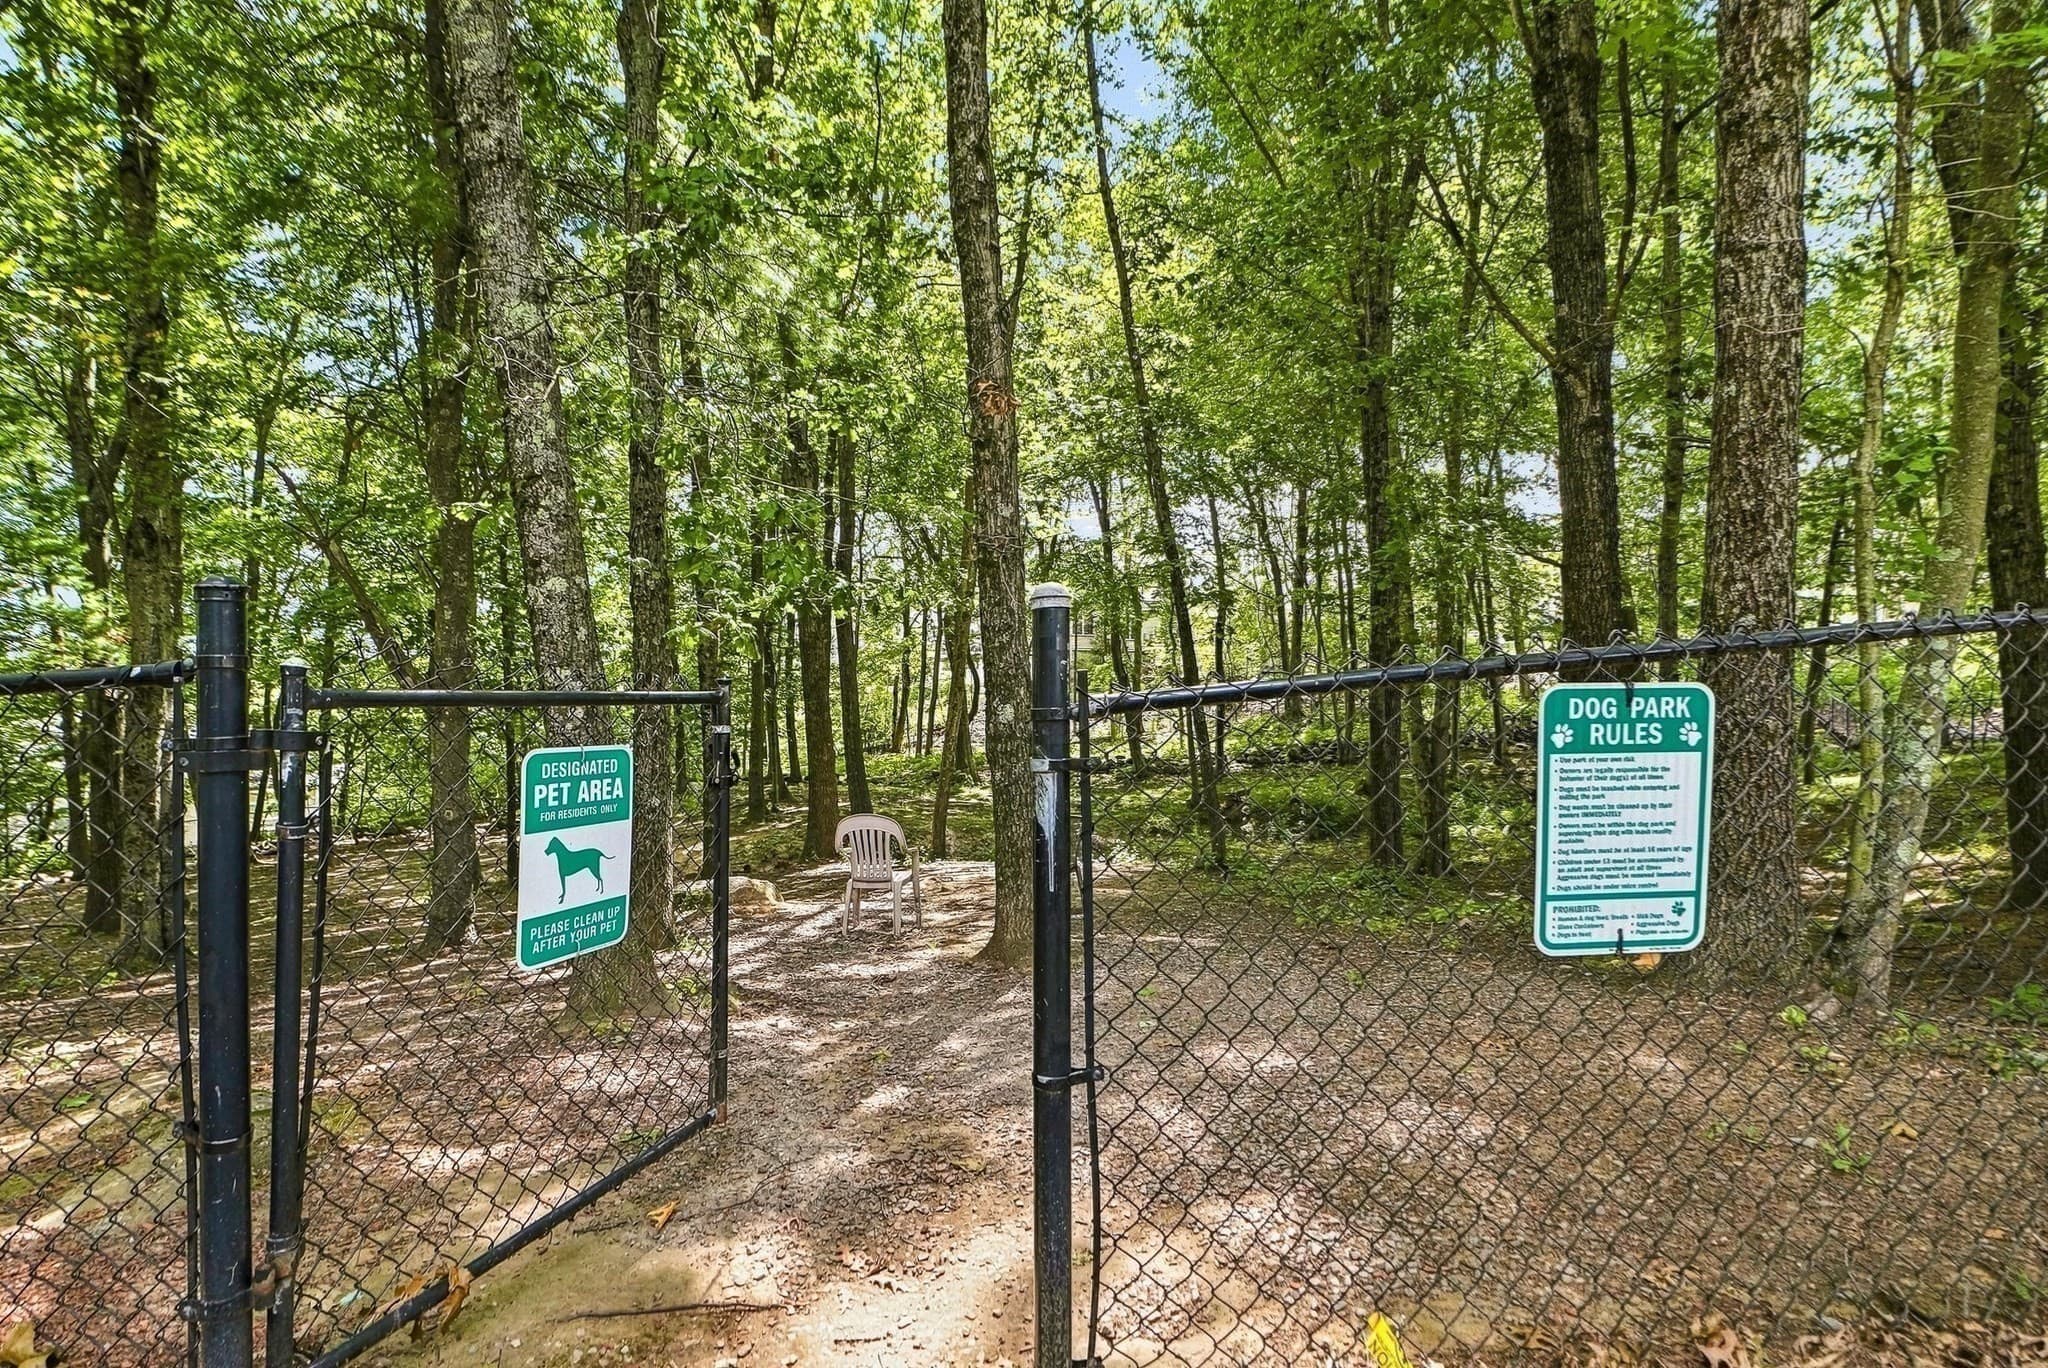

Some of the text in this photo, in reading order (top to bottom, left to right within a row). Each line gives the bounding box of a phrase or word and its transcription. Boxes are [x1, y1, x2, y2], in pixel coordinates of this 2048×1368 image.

[1569, 696, 1691, 720] DOG PARK
[1590, 723, 1663, 745] RULES
[541, 759, 618, 779] DESIGNATED
[534, 777, 623, 809] PET AREA
[540, 804, 618, 822] FOR RESIDENTS ONLY
[530, 906, 621, 941] PLEASE CLEAN UP
[532, 919, 617, 955] AFTER YOUR PET
